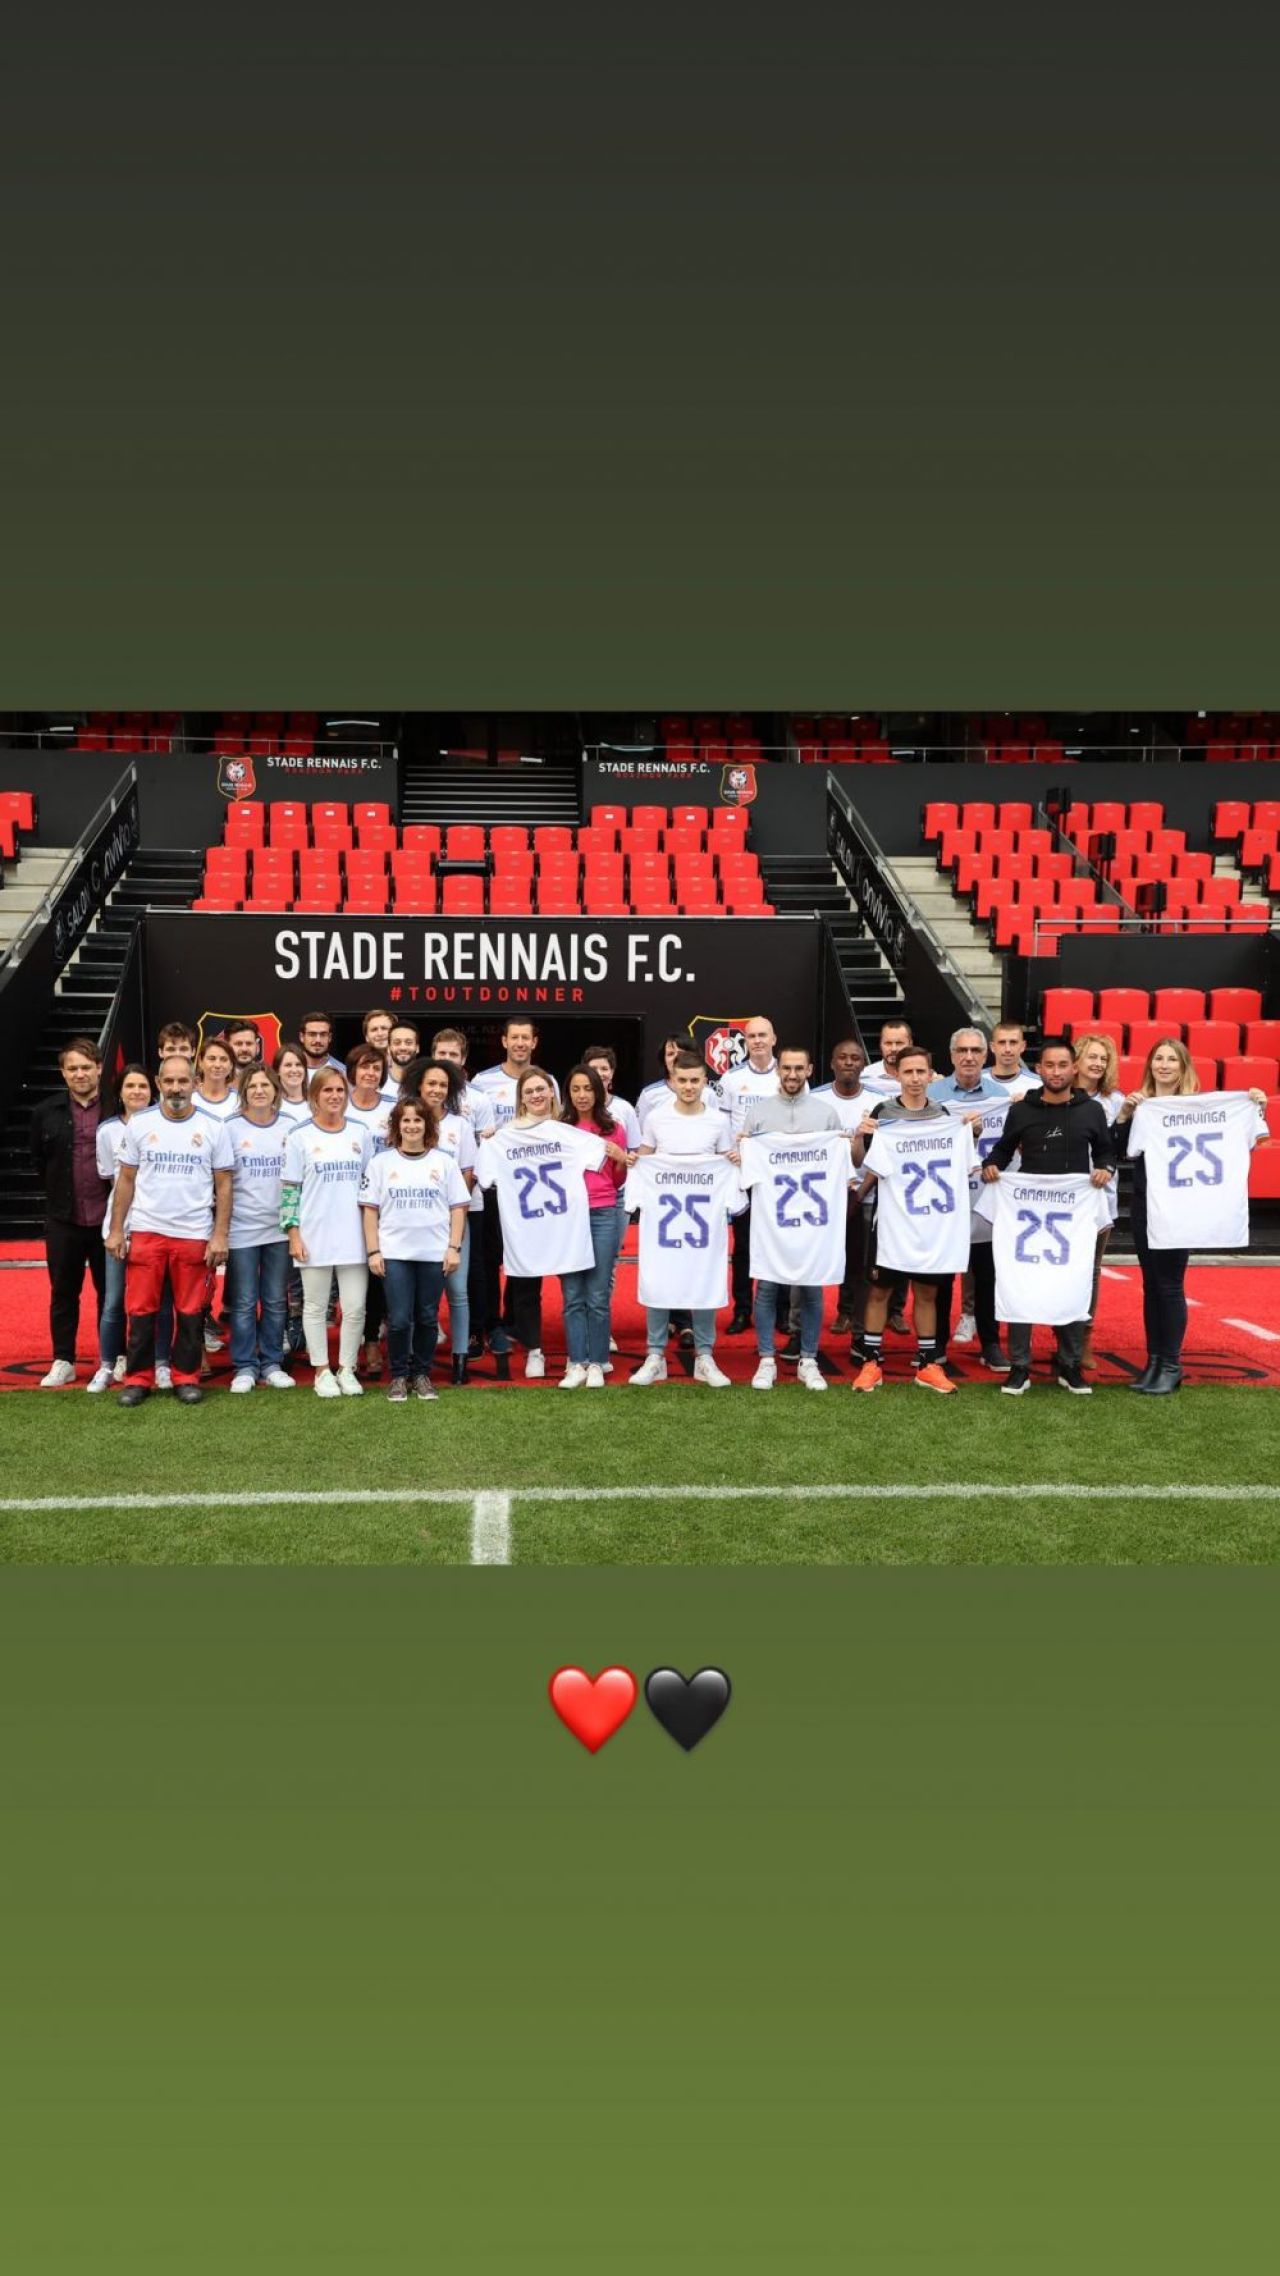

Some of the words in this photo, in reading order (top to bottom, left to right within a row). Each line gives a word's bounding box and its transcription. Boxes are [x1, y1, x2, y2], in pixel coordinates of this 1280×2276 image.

[267, 757, 303, 768] STADE
[307, 757, 357, 769] RENNAIS
[361, 758, 382, 769] F.C.
[598, 762, 634, 773] STADE
[638, 762, 687, 773] RENNAIS
[691, 763, 711, 773] F.C.
[274, 930, 405, 980] STADE
[424, 932, 608, 982] RENNAIS
[627, 934, 696, 983] F.C.
[390, 986, 584, 1001] #TOUTDONNER
[1162, 1110, 1226, 1128] CAMAVINGA
[506, 1141, 562, 1161] CAMAVINGA
[896, 1137, 953, 1153] CAMAVINGA
[147, 1150, 202, 1165] Emirates
[769, 1148, 828, 1165] CAMAVINGA
[1167, 1131, 1224, 1189] 25
[655, 1172, 714, 1185] CAMAVINGA
[902, 1158, 956, 1215] 25
[388, 1185, 440, 1198] Emirates
[513, 1160, 568, 1219] 25
[1013, 1186, 1076, 1204] CAMAVINGA
[774, 1171, 829, 1228] 25
[658, 1193, 711, 1249] 25
[1014, 1209, 1073, 1266] 25
